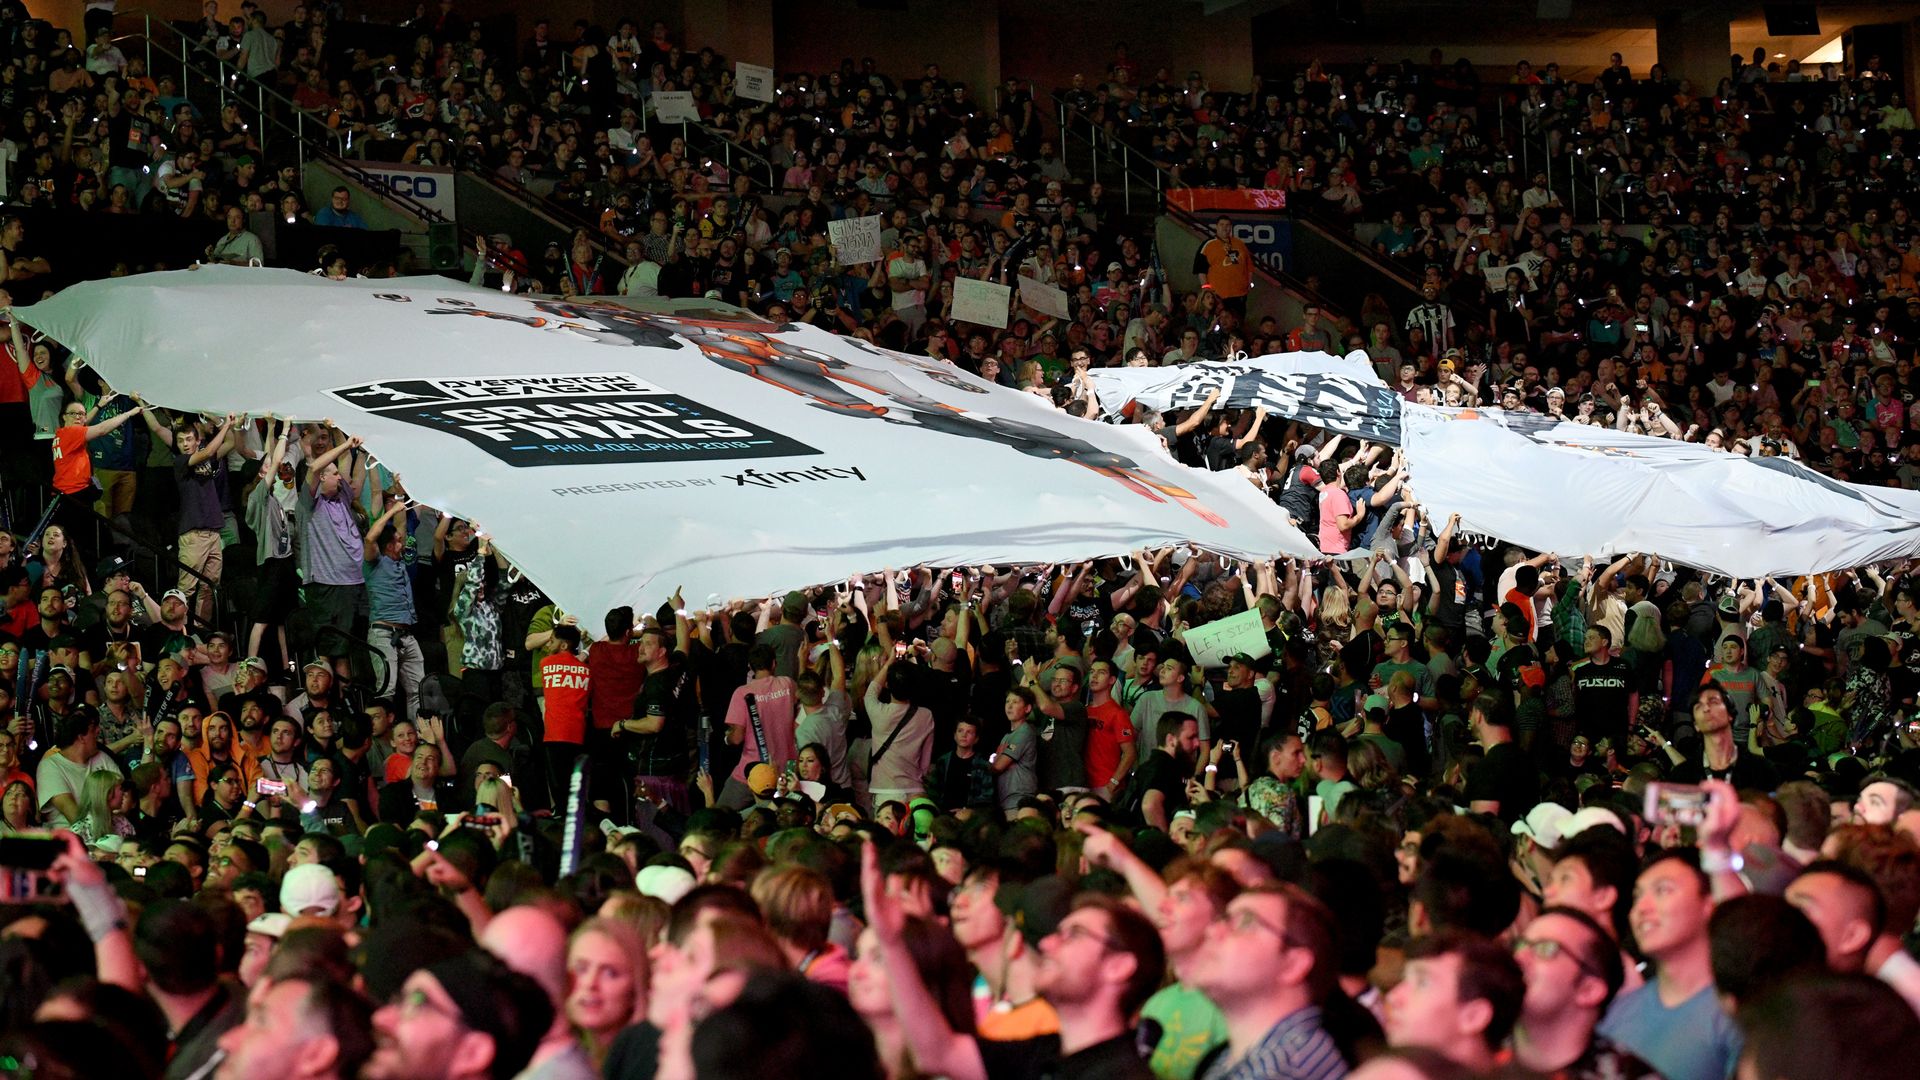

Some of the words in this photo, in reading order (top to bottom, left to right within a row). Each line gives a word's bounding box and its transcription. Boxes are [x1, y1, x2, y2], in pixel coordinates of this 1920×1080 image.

[832, 217, 862, 236] GIVE
[834, 231, 875, 250] SIGMA
[438, 376, 626, 389] OVERWATCH
[452, 383, 652, 398] LEAGUE
[441, 401, 680, 422] GRAND
[458, 419, 754, 441] FINALS
[543, 441, 701, 453] PHILADELPHIA
[552, 478, 687, 497] PRESENTED
[689, 477, 716, 488] BY
[721, 464, 868, 490] xfinity
[1192, 631, 1222, 656] LET
[1226, 619, 1260, 639] SIGMA
[543, 664, 590, 675] SUPPORT
[544, 674, 590, 691] TEAM
[1577, 678, 1625, 690] FUSION
[160, 700, 168, 711] OF
[165, 690, 174, 702] US
